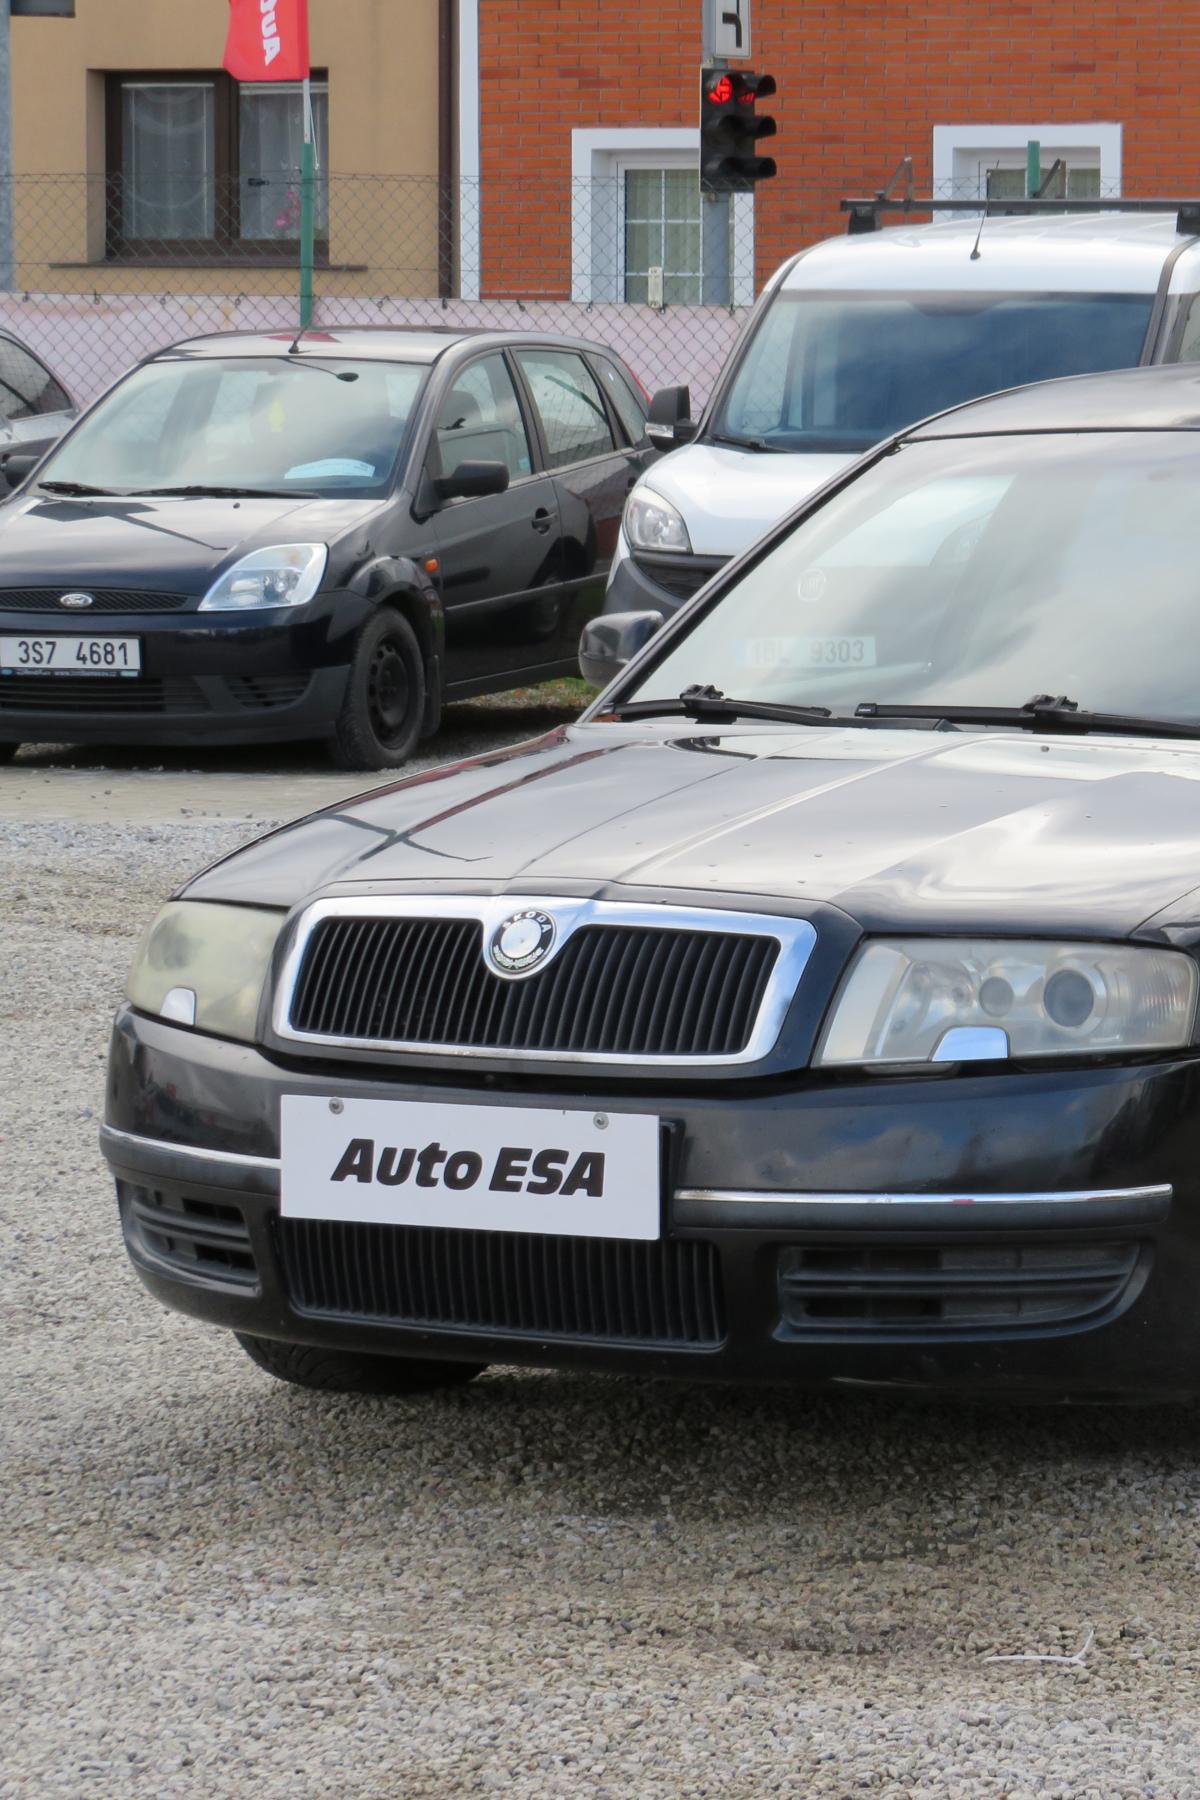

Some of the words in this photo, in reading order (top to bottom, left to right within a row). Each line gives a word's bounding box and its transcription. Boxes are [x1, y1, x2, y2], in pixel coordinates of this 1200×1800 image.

[18, 640, 57, 665] 3S7
[76, 641, 128, 666] 4681
[810, 639, 865, 664] 9303
[330, 1138, 483, 1191] Auto
[488, 1146, 606, 1198] ESA
